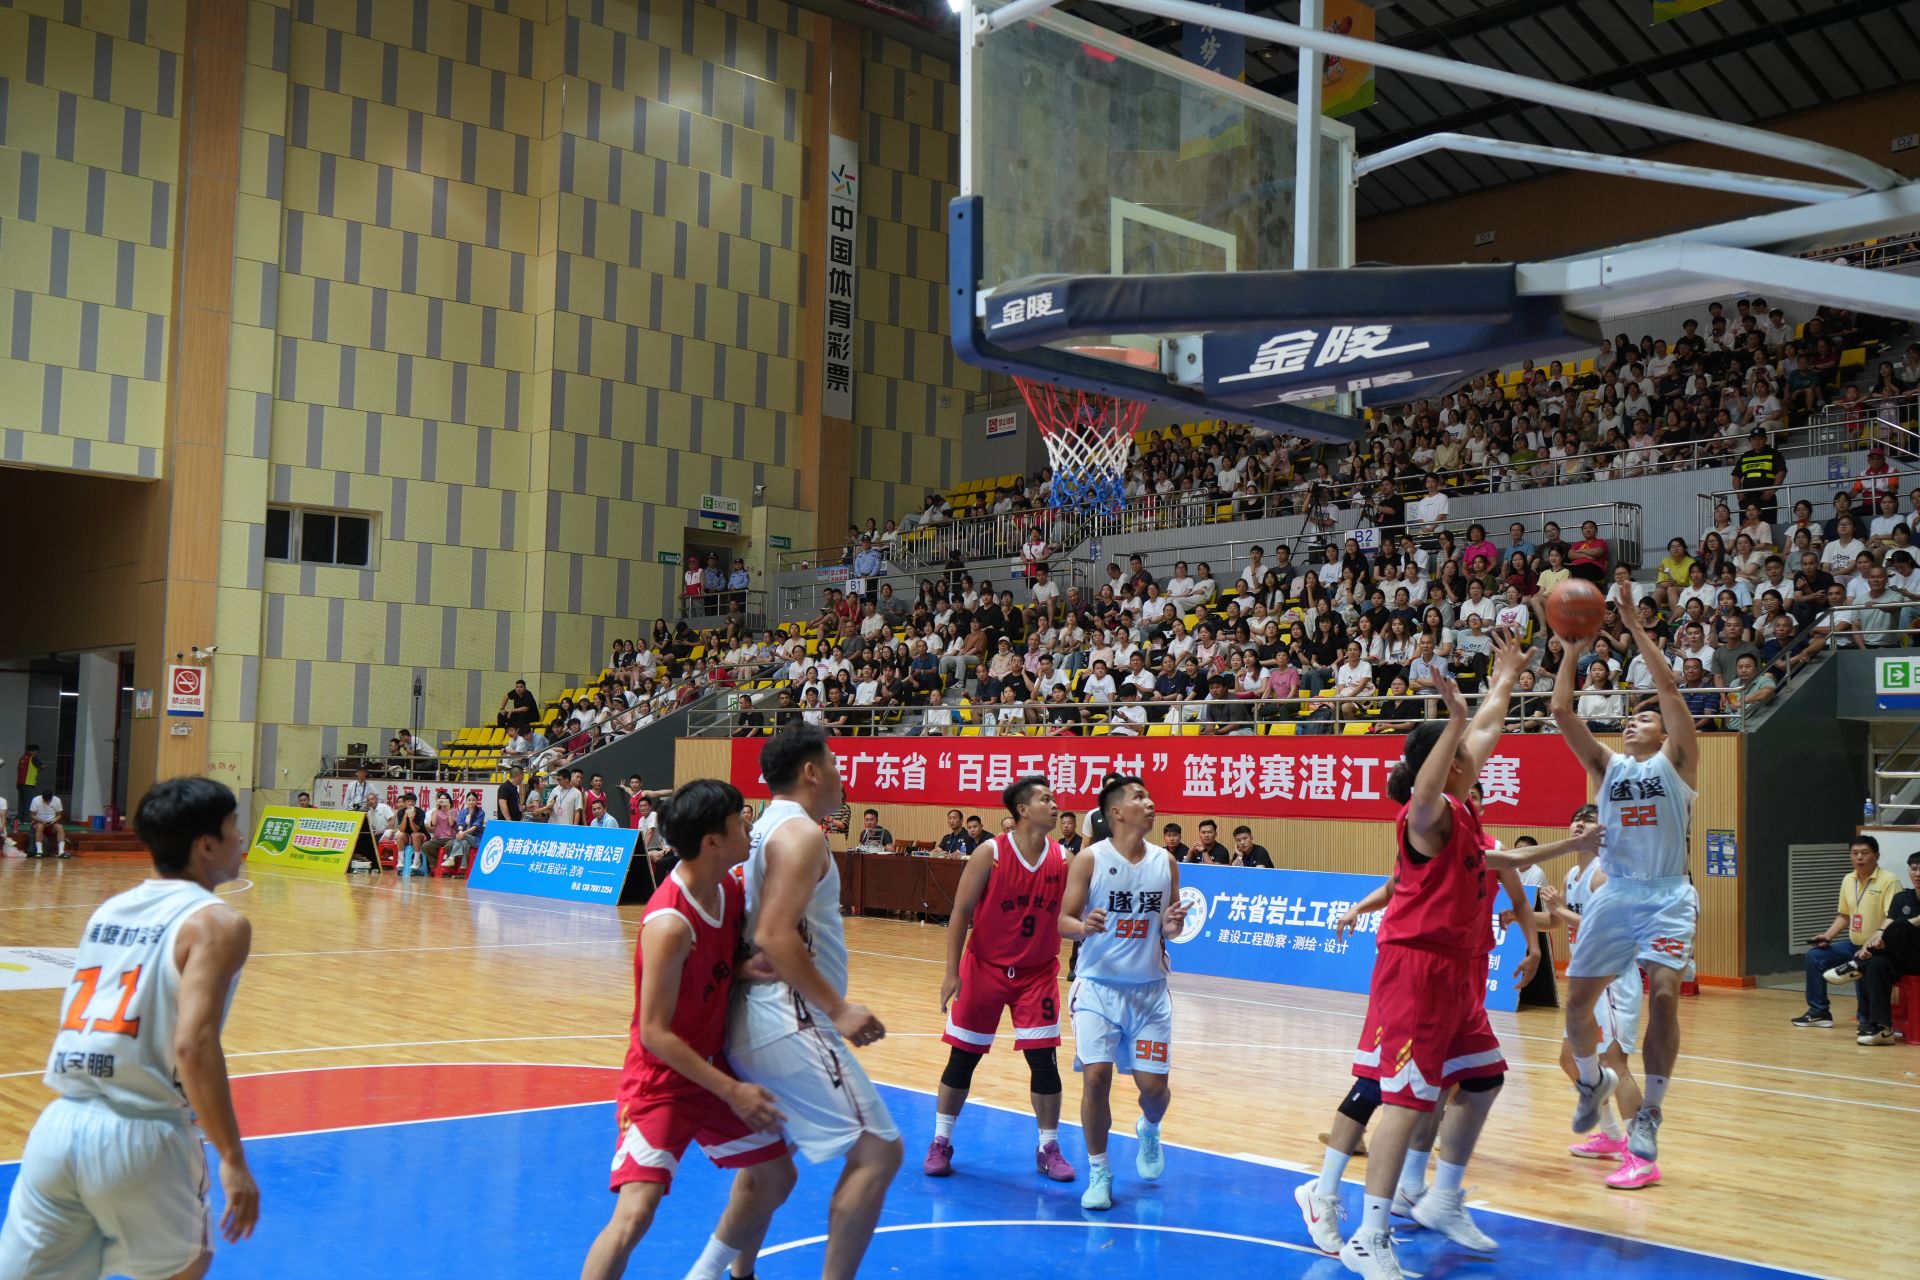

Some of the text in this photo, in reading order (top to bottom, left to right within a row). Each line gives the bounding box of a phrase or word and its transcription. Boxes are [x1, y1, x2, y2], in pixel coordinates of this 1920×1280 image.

[827, 205, 853, 393] 中国体育彩票
[998, 291, 1059, 325] 金陵
[1235, 325, 1410, 376] 金陵
[1355, 530, 1373, 543] B2
[850, 580, 861, 591] B1
[171, 696, 201, 706] 禁止吸烟
[1610, 776, 1666, 802] 遂溪
[1620, 804, 1658, 827] 22
[504, 838, 624, 864] 海南省水科勘测设计有限公司
[528, 861, 585, 878] 水利工程设计、咨询
[1109, 891, 1163, 914] 遂溪
[1021, 914, 1036, 938] 9
[1115, 919, 1150, 939] 99
[61, 963, 143, 1040] 11
[1040, 997, 1056, 1021] 9
[1135, 1039, 1169, 1063] 99
